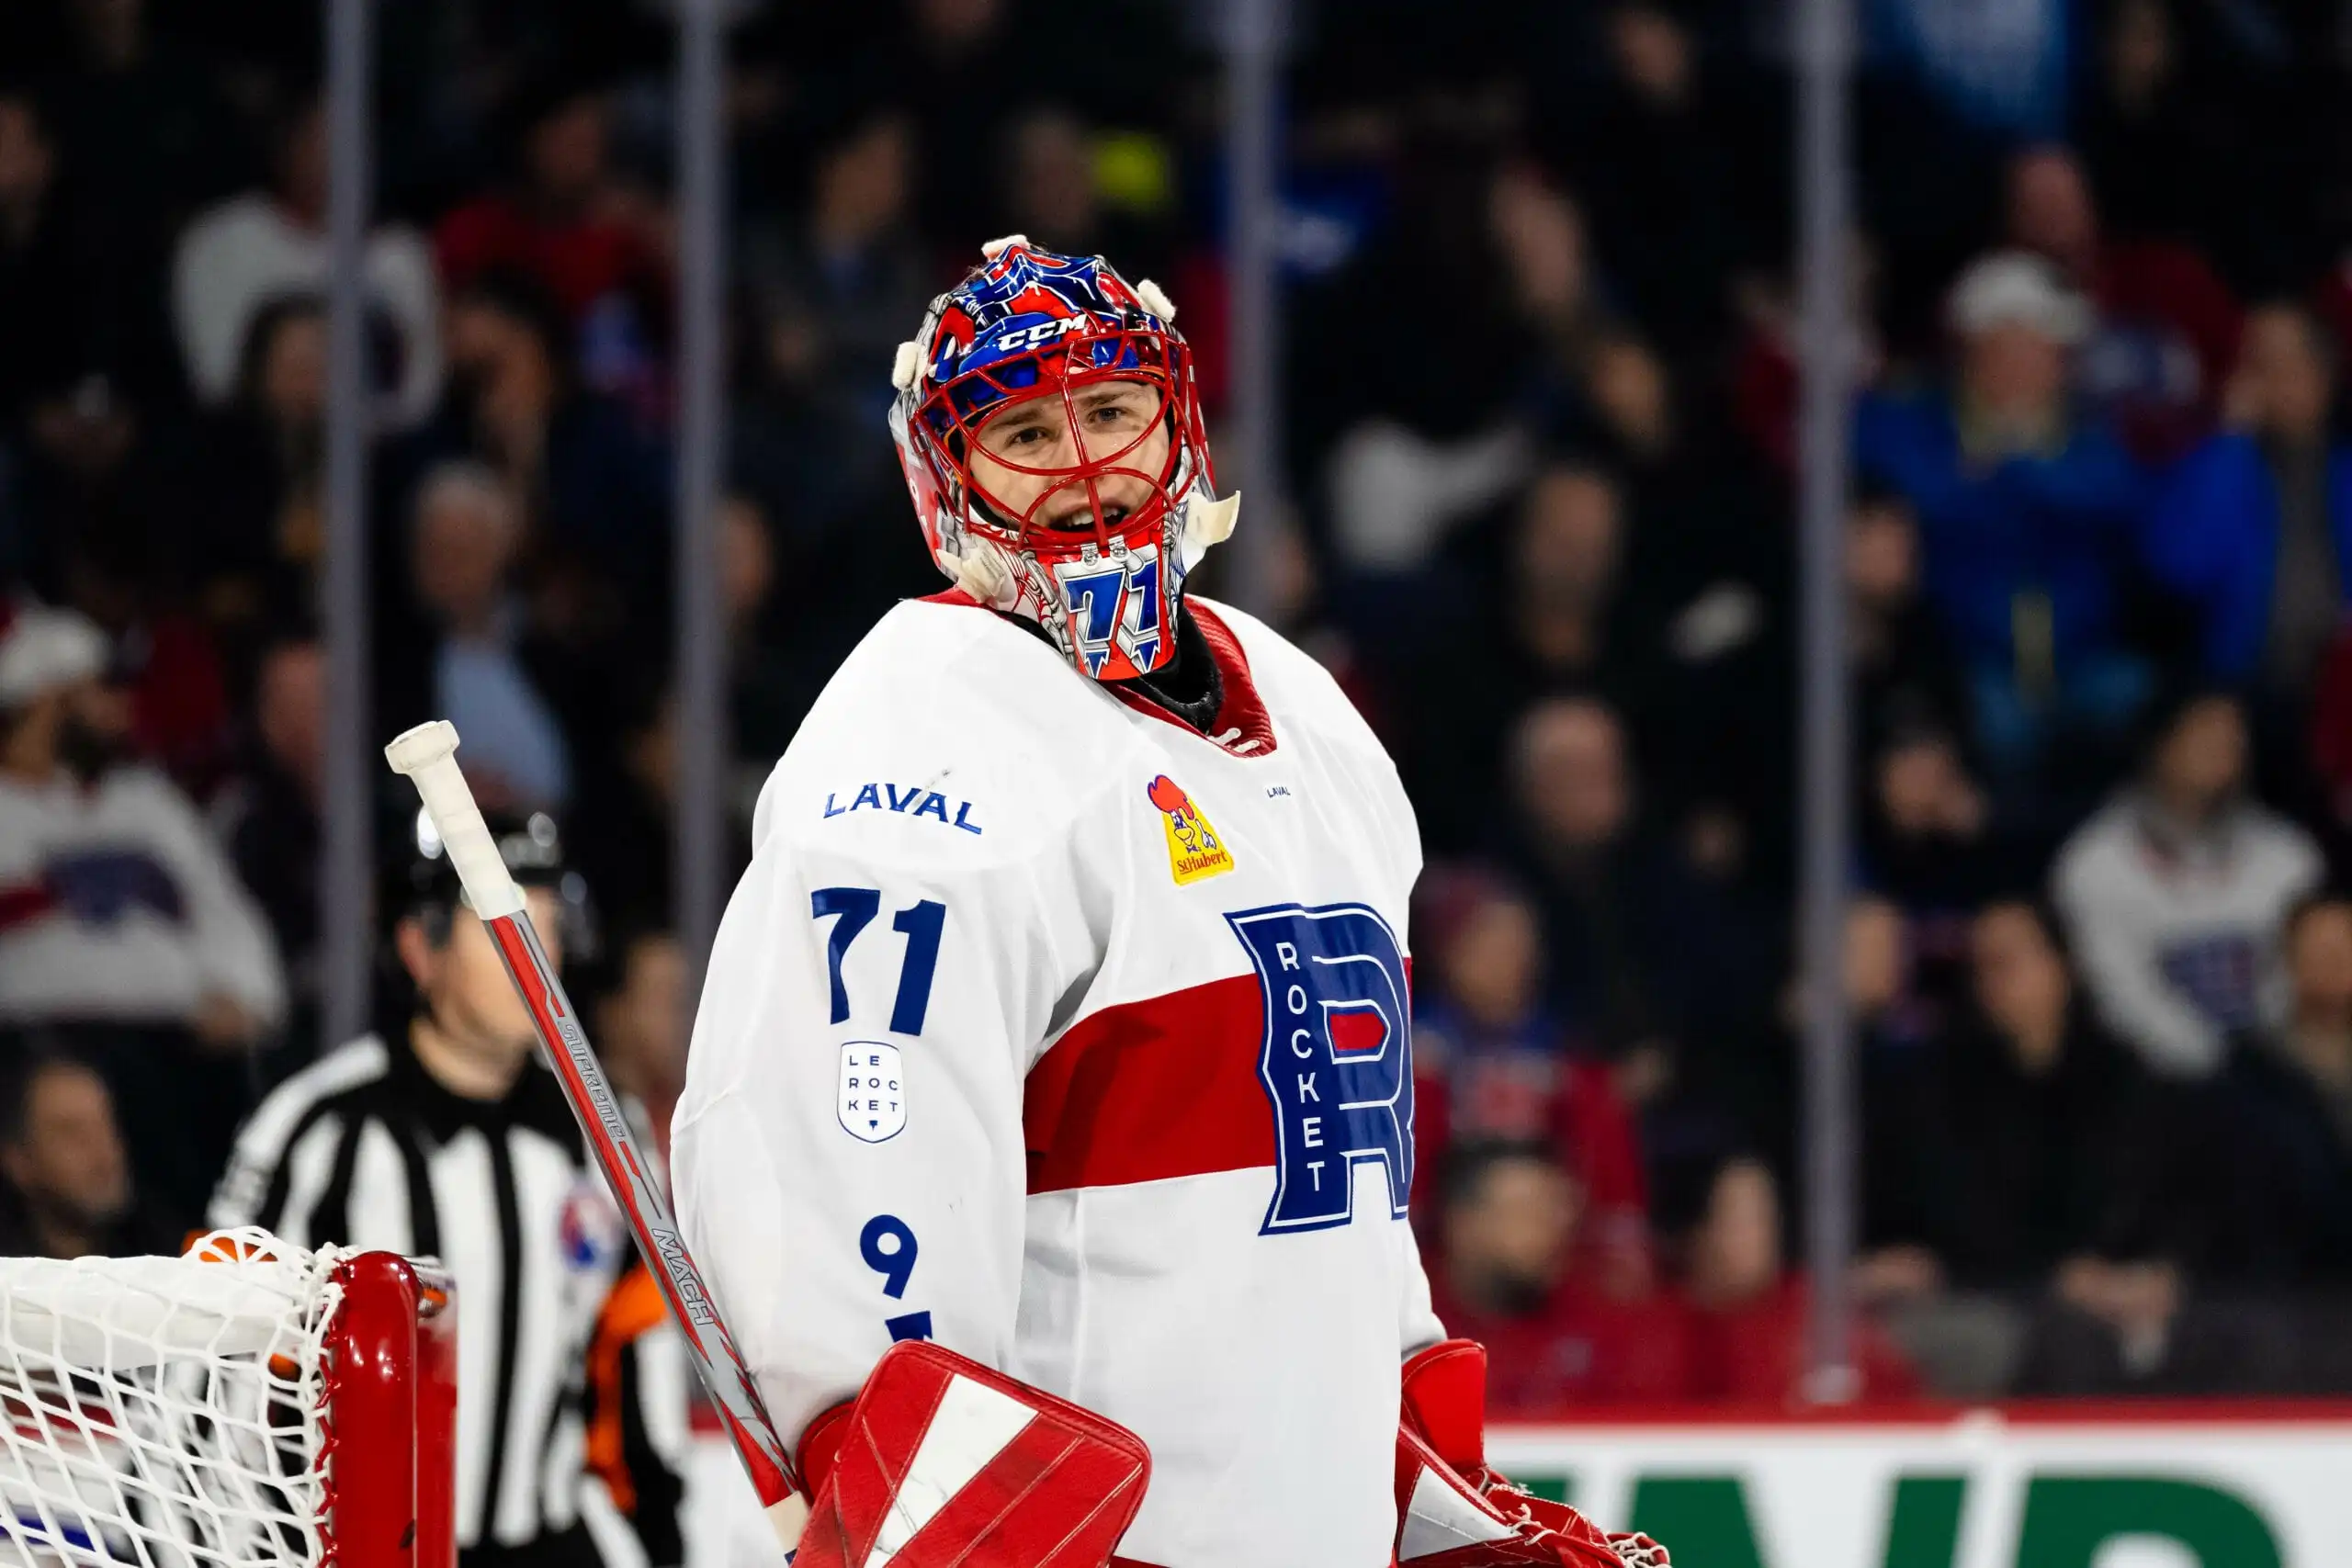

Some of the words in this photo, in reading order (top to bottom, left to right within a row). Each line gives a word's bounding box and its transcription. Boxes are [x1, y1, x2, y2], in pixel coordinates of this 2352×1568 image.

[998, 314, 1088, 352] CCM
[1057, 553, 1161, 676] 71
[823, 783, 982, 835] LAVAL
[1267, 786, 1290, 797] LAVAL
[811, 887, 946, 1036] 71
[561, 1024, 626, 1138] SUPREME
[849, 1055, 879, 1066] LE
[849, 1077, 899, 1090] ROC
[1276, 942, 1325, 1191] ROCKET
[848, 1100, 898, 1112] KET
[651, 1228, 714, 1325] MACH
